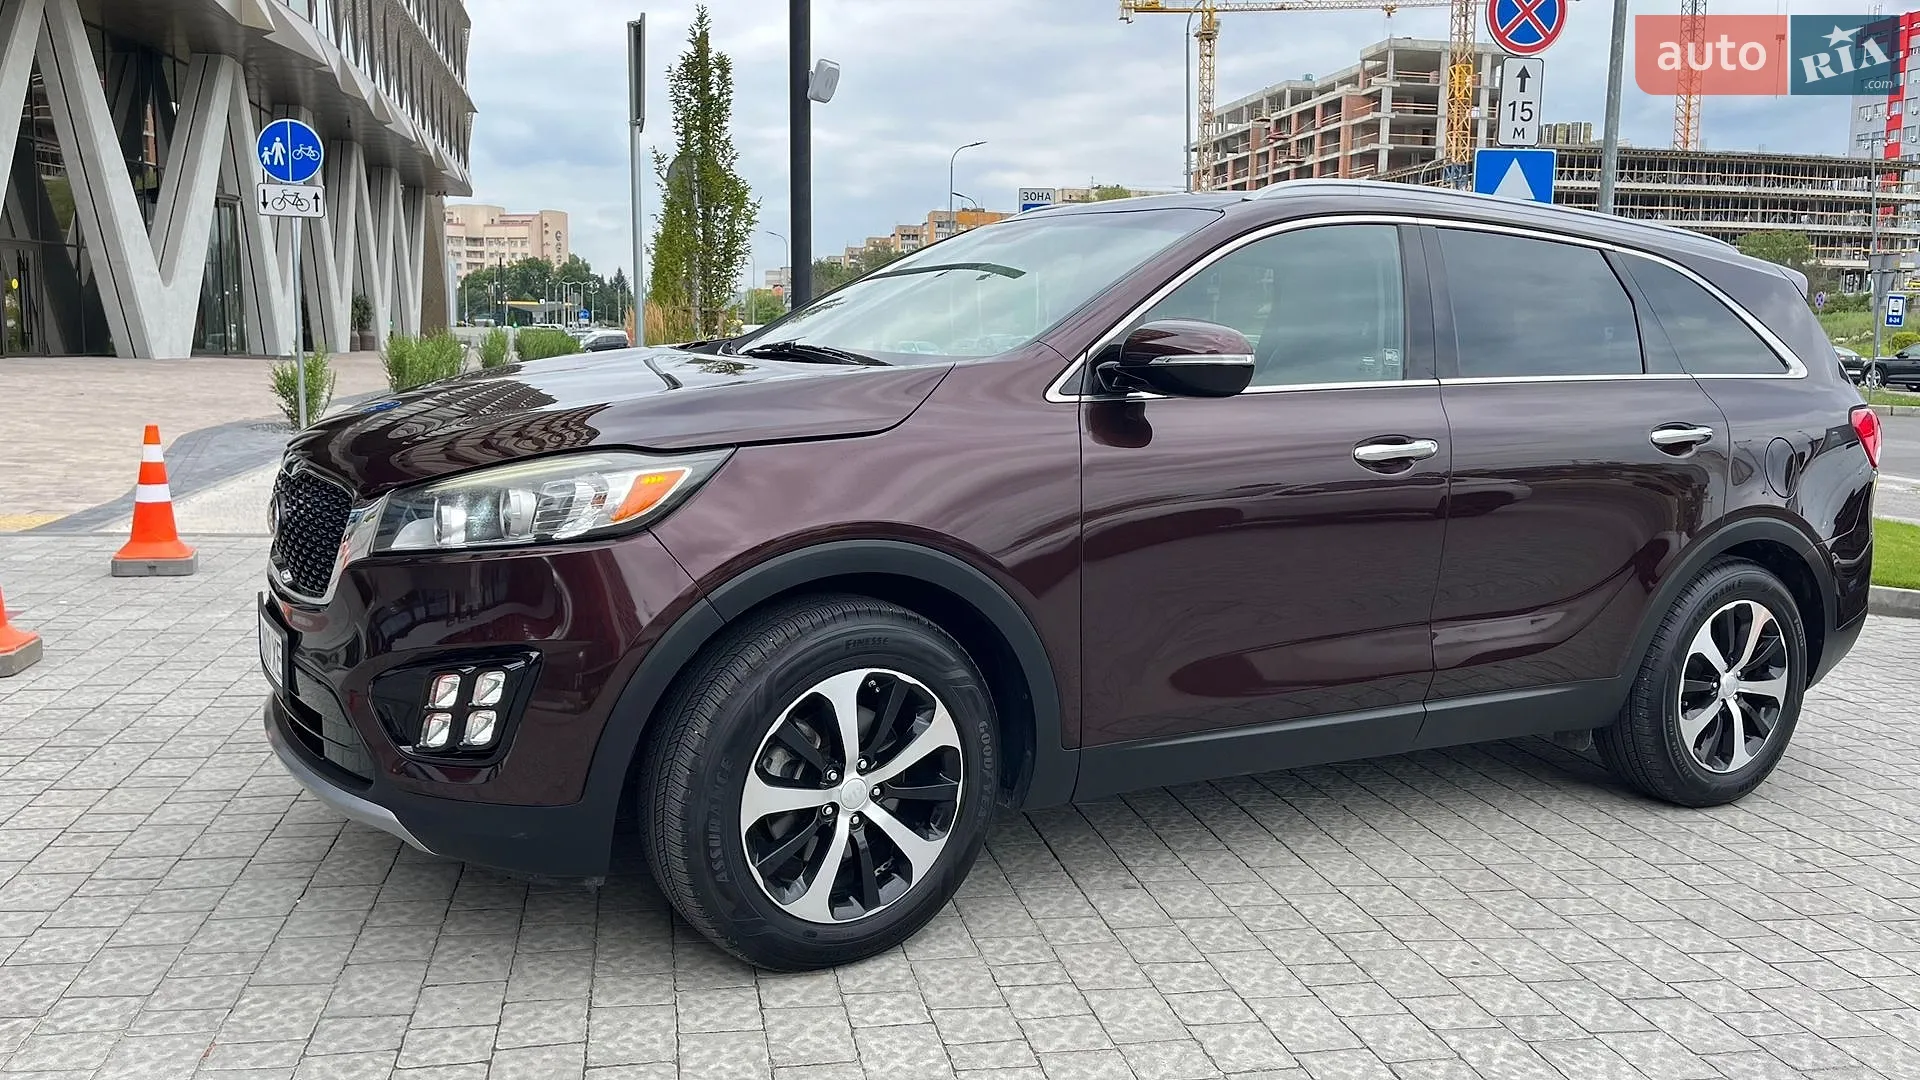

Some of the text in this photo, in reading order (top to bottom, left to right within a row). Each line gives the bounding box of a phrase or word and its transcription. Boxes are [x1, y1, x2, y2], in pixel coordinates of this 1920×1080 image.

[1508, 100, 1533, 122] 15
[1023, 191, 1051, 201] ЗОНА
[844, 636, 889, 651] FINESSE
